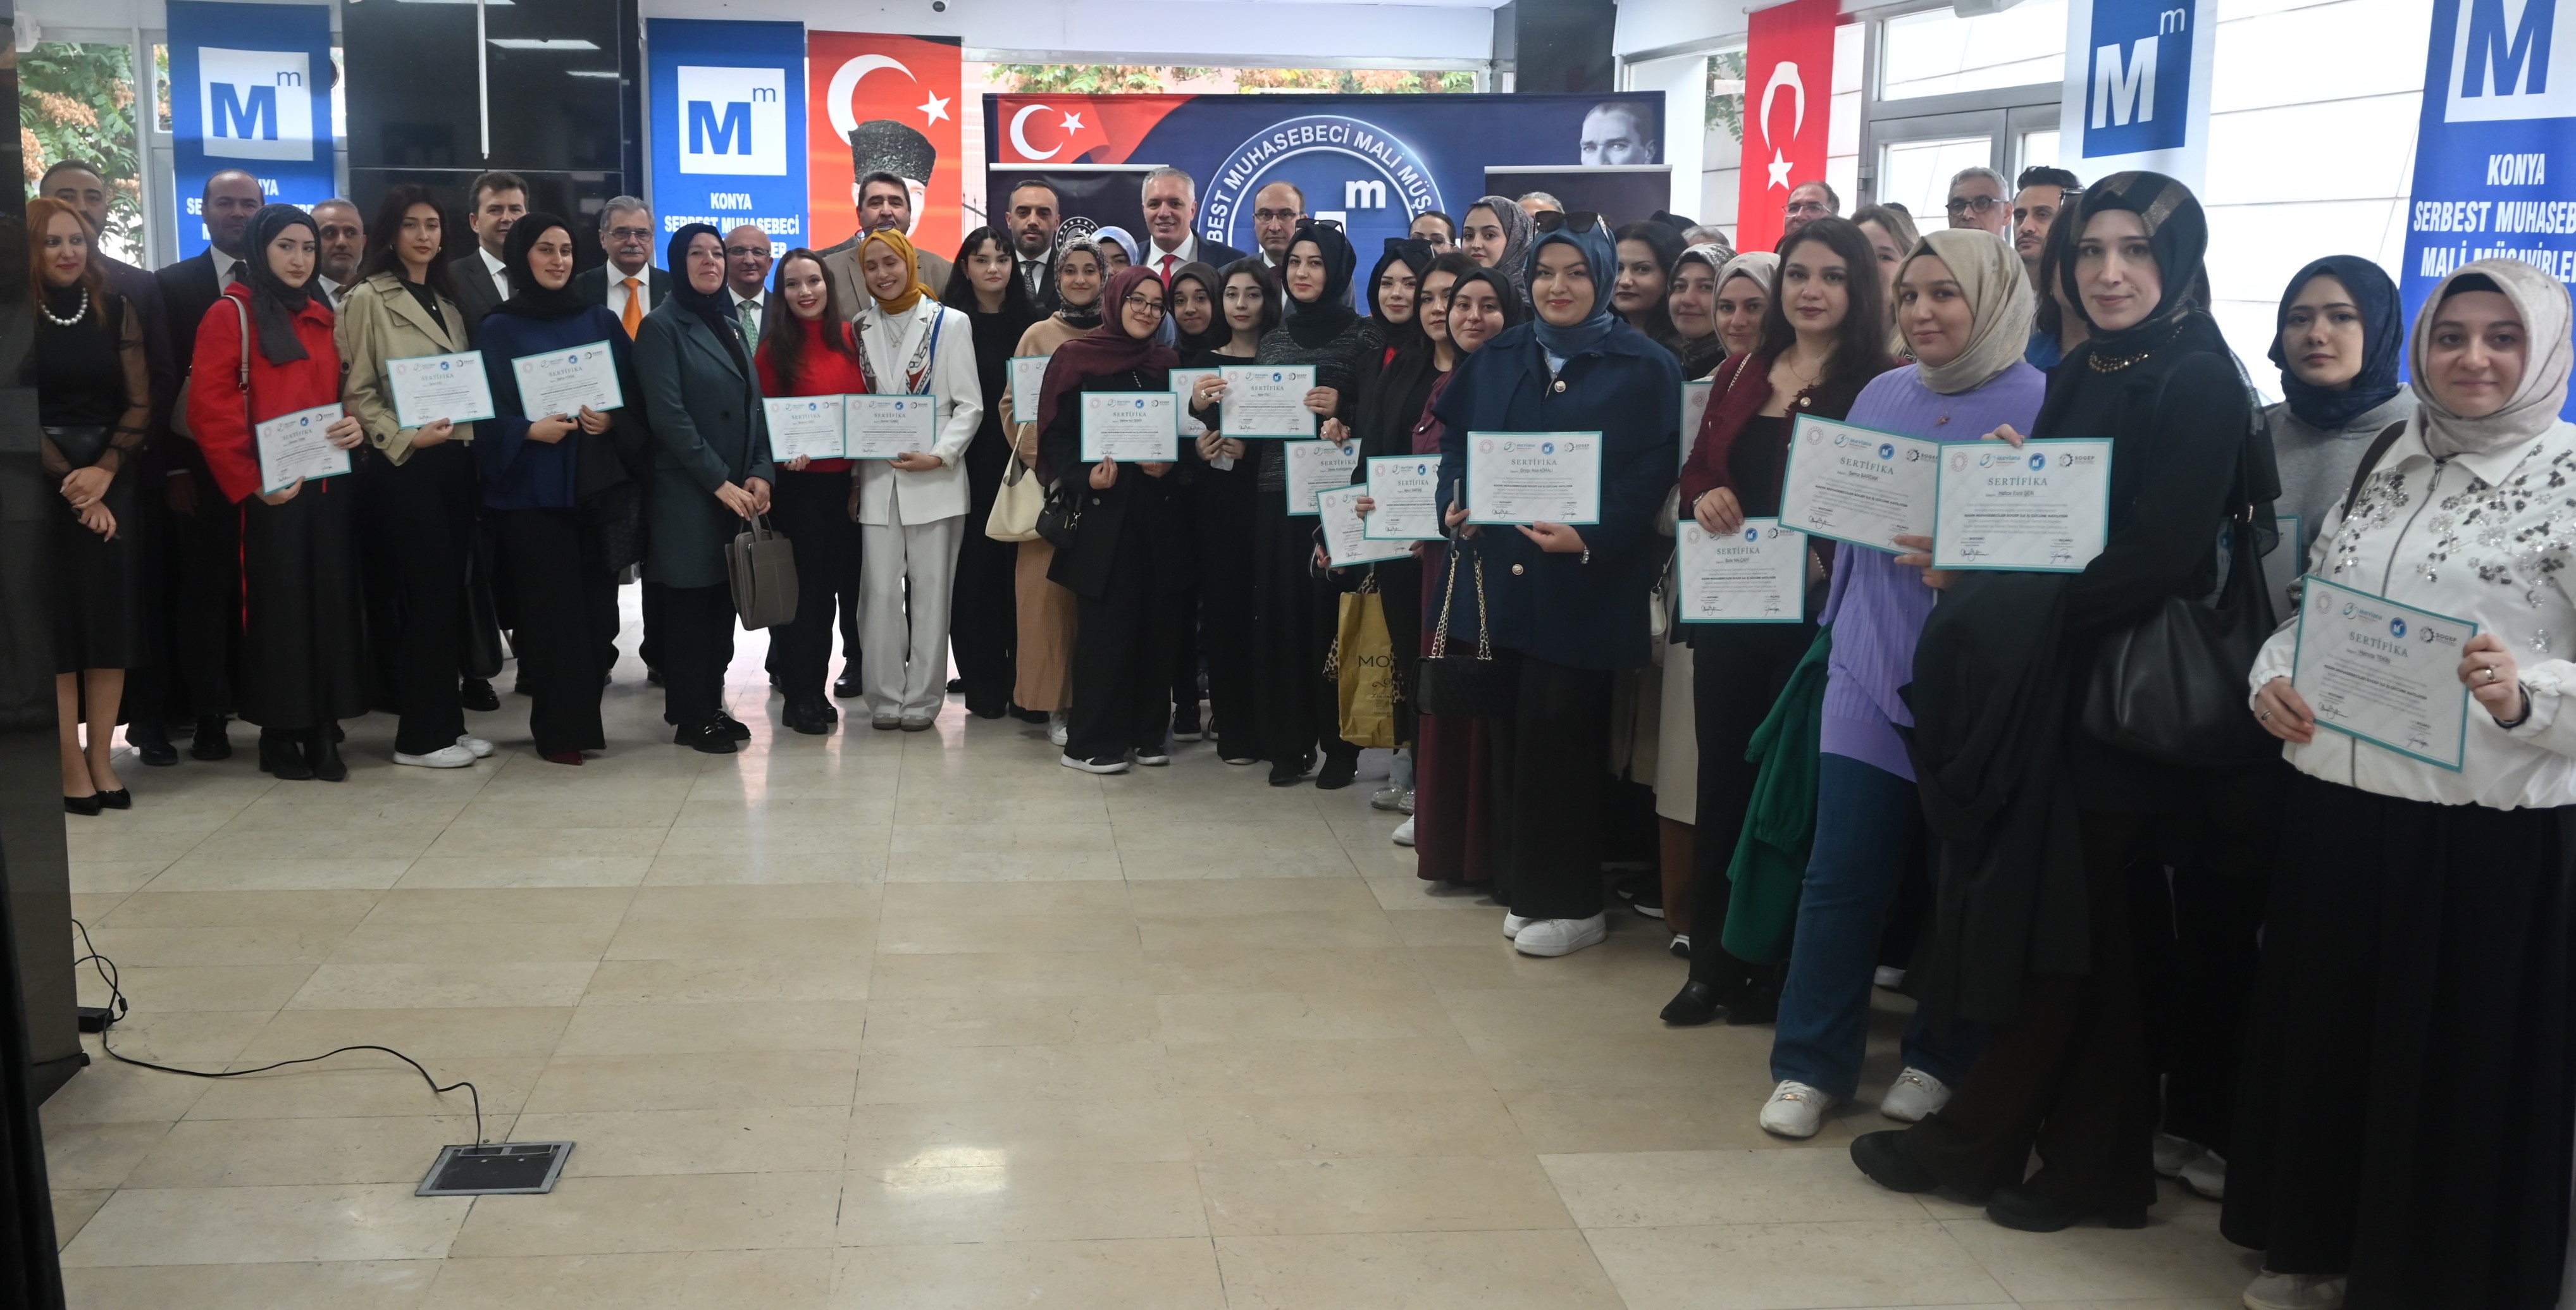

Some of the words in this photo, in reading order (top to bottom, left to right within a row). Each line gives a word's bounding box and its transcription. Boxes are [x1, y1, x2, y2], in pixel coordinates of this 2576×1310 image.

[2487, 153, 2545, 185] KONYA
[1206, 190, 1232, 243] BEST
[1223, 123, 1350, 190] MUHASEBECİ
[1353, 130, 1404, 169] MALİ
[710, 193, 753, 210] KONYA
[2413, 201, 2492, 233] SERBEST
[1840, 457, 1894, 474] SERTİFİKA
[1988, 476, 2048, 486] SERTİFİKA
[1716, 547, 1760, 555] SERTİFİKA
[2349, 631, 2408, 658] SERTİFİKA
[2436, 633, 2457, 643] SOGEP
